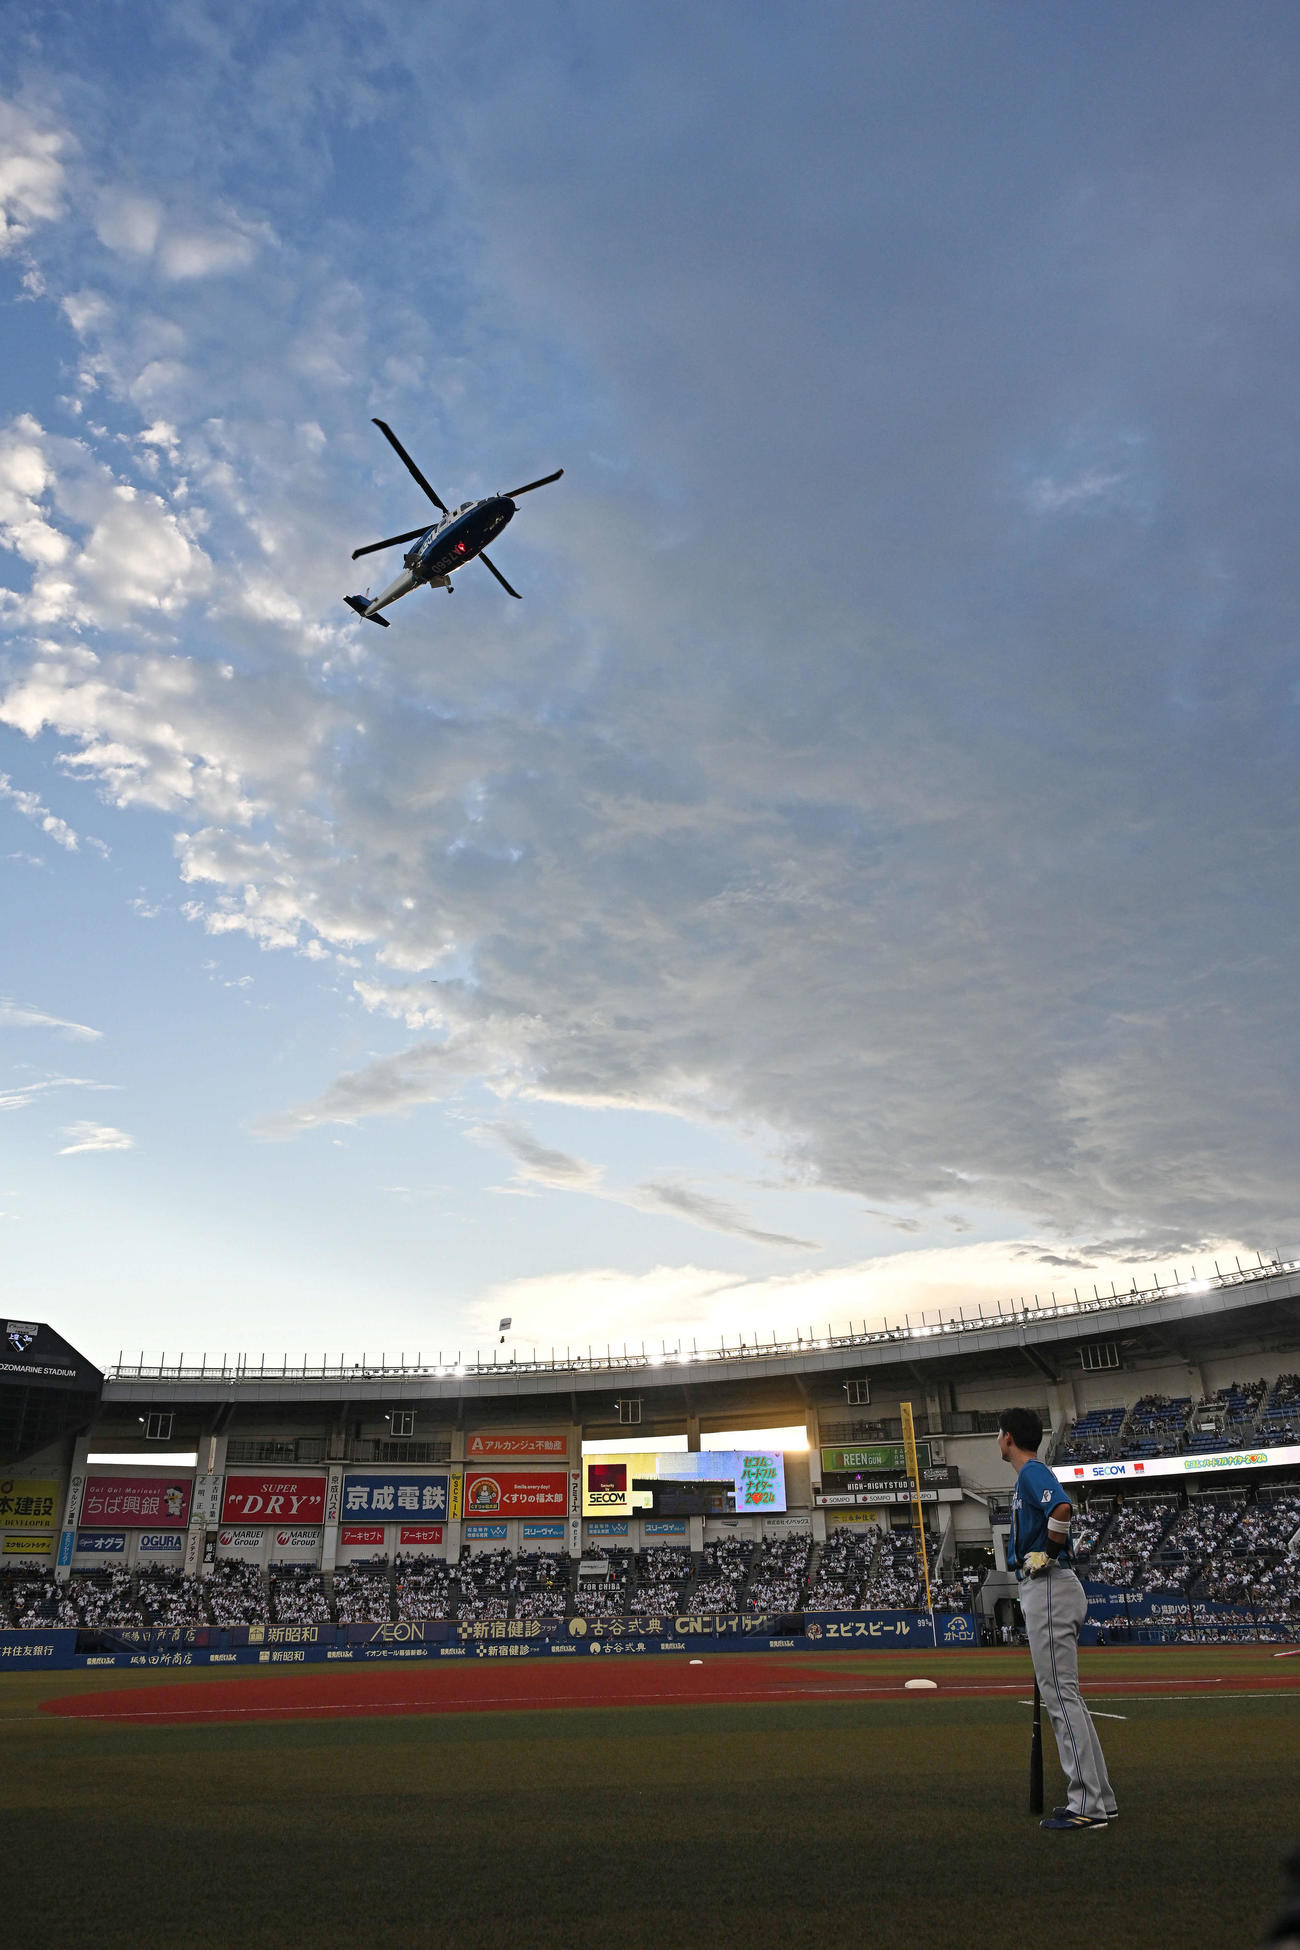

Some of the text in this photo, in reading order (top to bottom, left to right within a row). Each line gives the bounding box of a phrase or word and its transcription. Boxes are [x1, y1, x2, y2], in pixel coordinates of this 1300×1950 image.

[43, 1367, 76, 1377] STADIUM
[485, 1440, 562, 1451] アルカンジュ不動産
[1093, 1465, 1125, 1477] SECOM
[260, 1483, 297, 1493] SUPER
[329, 1475, 339, 1510] 京成バス
[345, 1486, 446, 1511] 京成電鉄
[502, 1493, 563, 1503] くすりの福太郎
[589, 1492, 626, 1503] SECOM
[87, 1495, 161, 1515] ちば興銀
[232, 1530, 264, 1539] MARUEI
[290, 1530, 320, 1539] MARUEI
[344, 1531, 382, 1541] アーキセプト
[403, 1531, 440, 1541] アーキセプト
[94, 1537, 125, 1550] オグラ
[141, 1535, 182, 1547] OGURA
[234, 1538, 260, 1547] Group
[291, 1538, 316, 1547] Group
[583, 1583, 621, 1591] FOR CHIBA
[590, 1617, 664, 1636] 古谷式典
[825, 1619, 911, 1638] ヱビスビール
[267, 1626, 319, 1643] 新昭和
[943, 1631, 975, 1641] オトロン
[0, 1645, 55, 1657] 井住友銀行
[364, 1649, 428, 1657] イオンモール幕張新都心
[603, 1642, 647, 1653] 古谷式典
[271, 1651, 305, 1662] 新昭和
